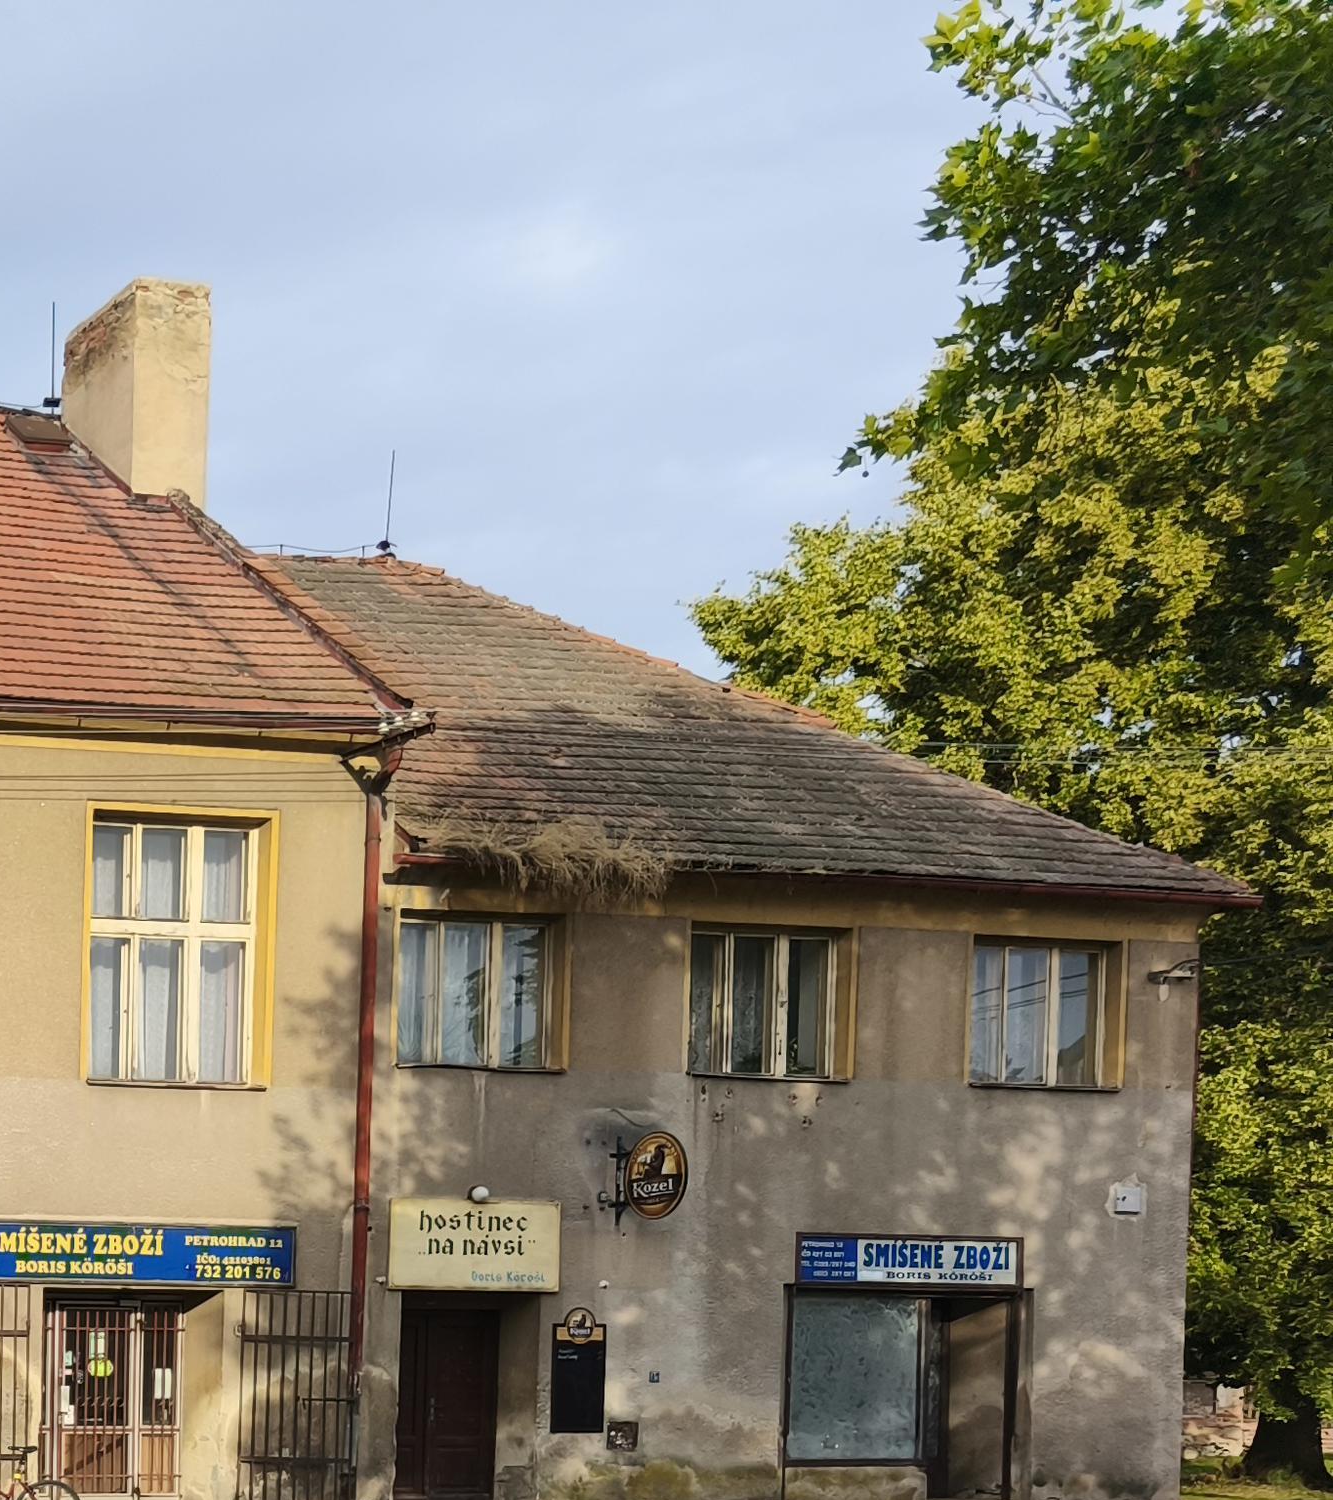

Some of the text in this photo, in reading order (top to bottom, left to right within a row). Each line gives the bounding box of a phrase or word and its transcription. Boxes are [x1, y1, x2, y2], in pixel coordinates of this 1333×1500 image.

[633, 1178, 674, 1198] Kozel
[419, 1210, 528, 1233] hostinec
[93, 1228, 164, 1256] ZBOŽÍ
[185, 1235, 283, 1248] PETROHRAD 12
[863, 1238, 1010, 1270] SMÍŠENÉ ZBOŽÍ
[15, 1260, 66, 1274] BORIS
[195, 1265, 281, 1279] 732 201 576
[886, 1271, 931, 1280] BORIS
